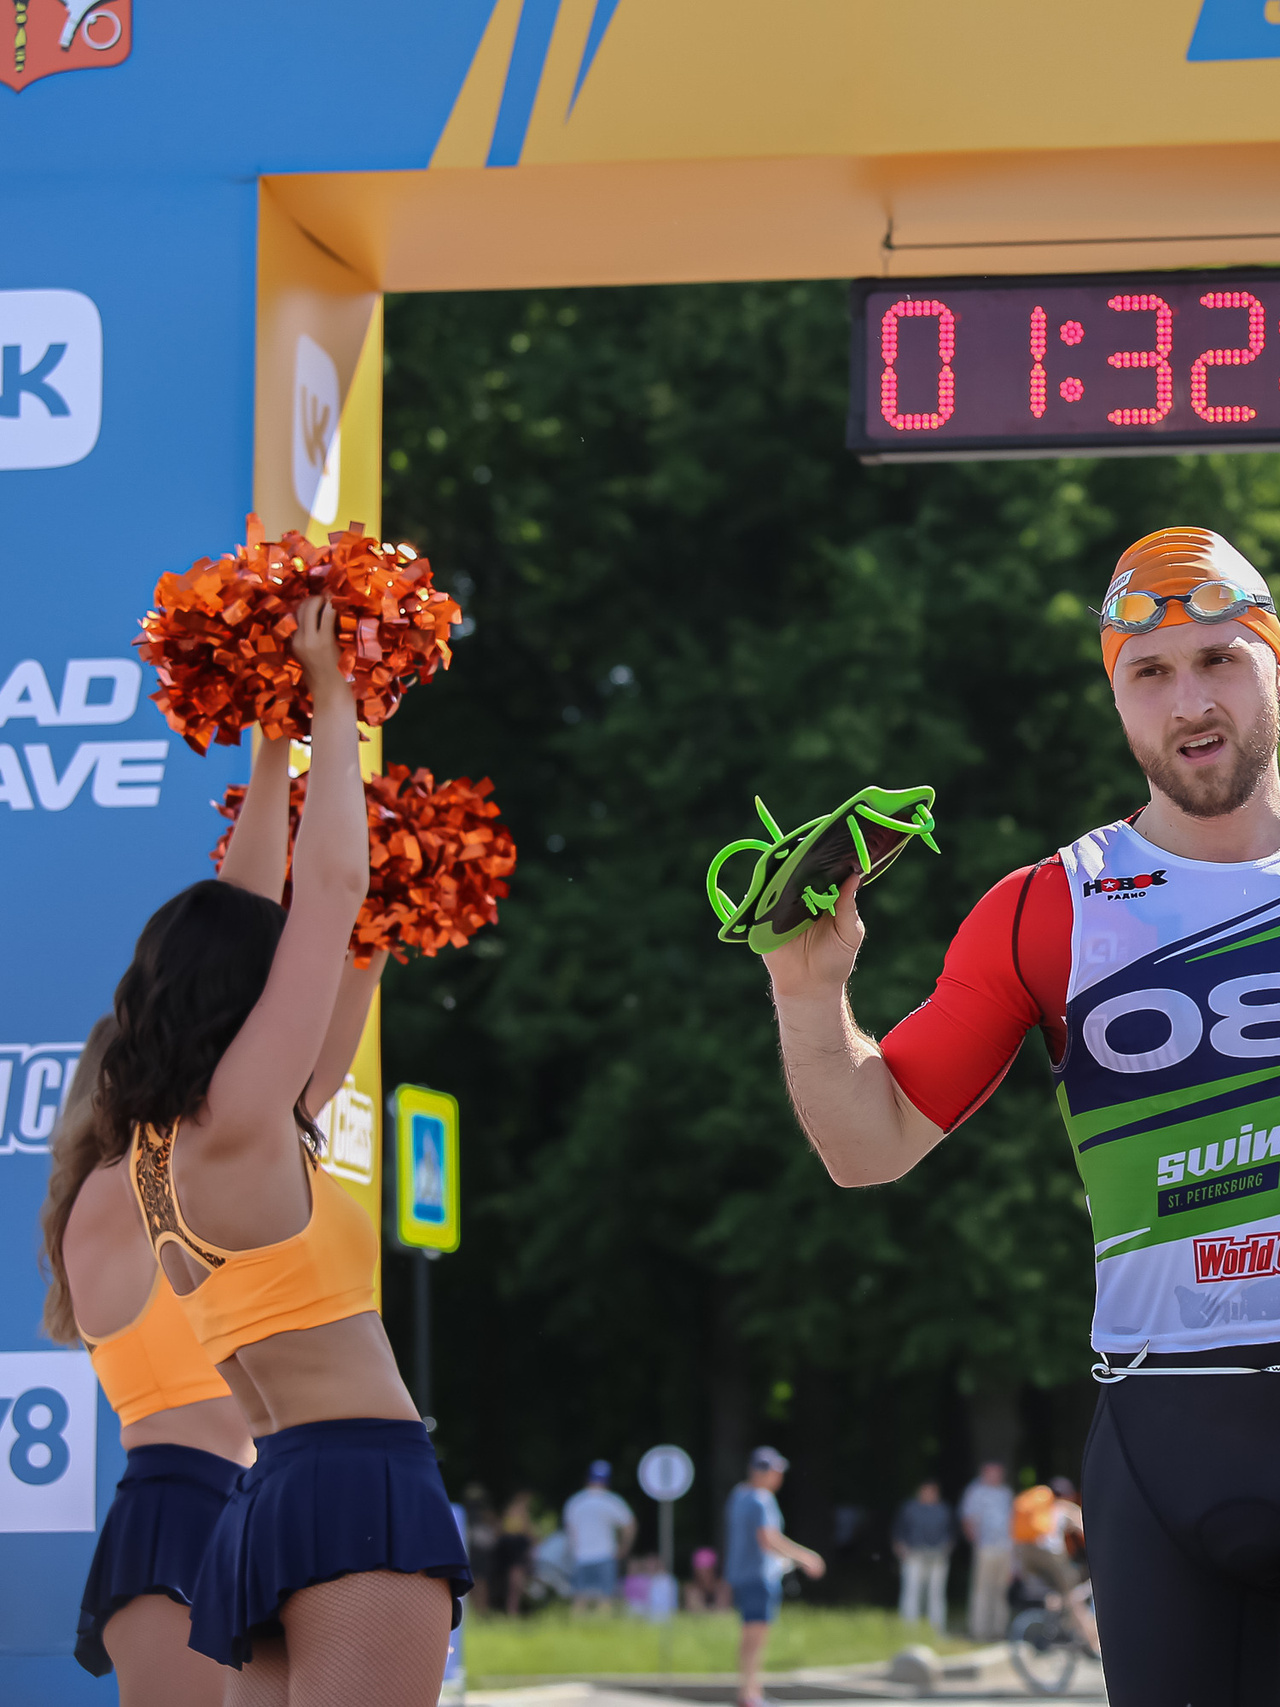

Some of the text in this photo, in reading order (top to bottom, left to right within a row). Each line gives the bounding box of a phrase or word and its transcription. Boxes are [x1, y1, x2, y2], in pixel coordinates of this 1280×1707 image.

[1107, 891, 1147, 901] РАДИО
[1168, 1172, 1264, 1209] ST. PETERSBURG
[1199, 1238, 1275, 1278] World
